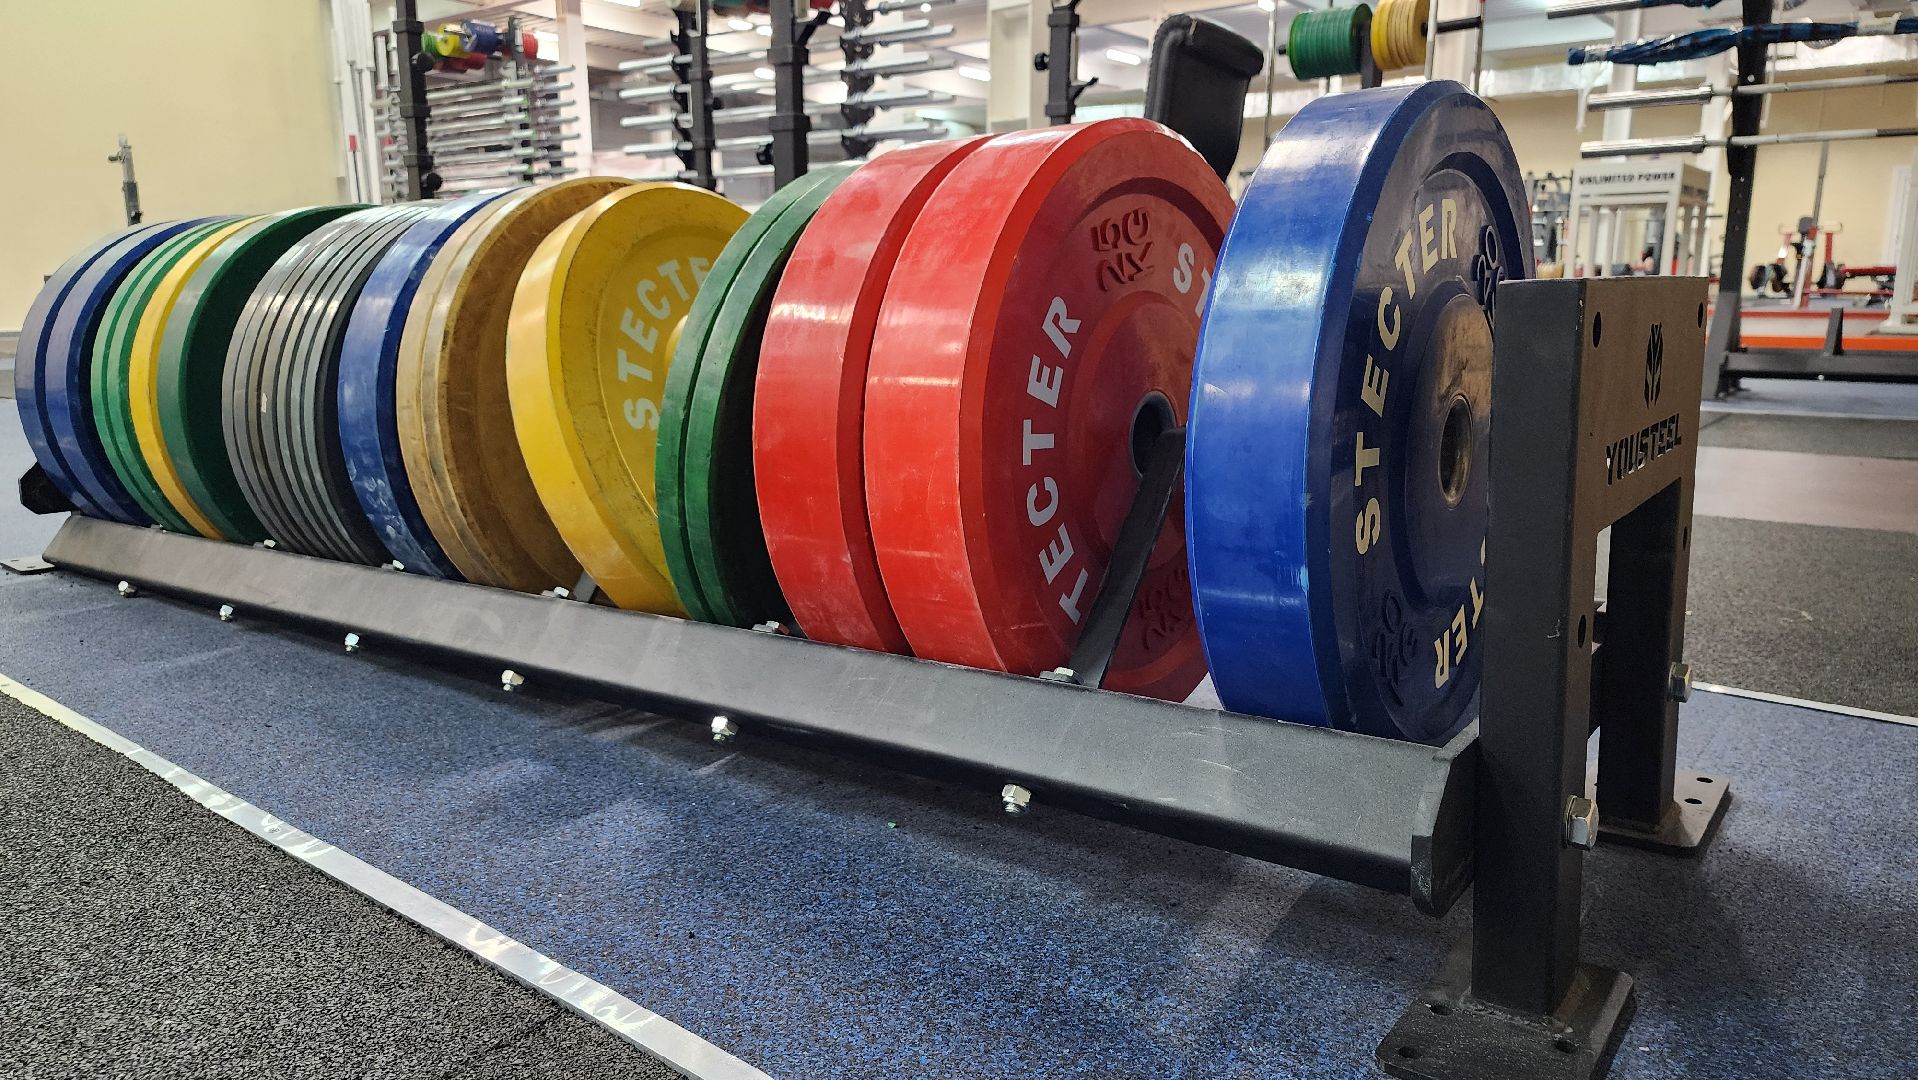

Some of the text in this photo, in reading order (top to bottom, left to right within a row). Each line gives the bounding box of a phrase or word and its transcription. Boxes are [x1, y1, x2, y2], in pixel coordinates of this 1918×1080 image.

[1579, 171, 1675, 186] UNLIMITED POWER
[1355, 197, 1457, 557] STECTER
[1606, 412, 1682, 486] YOUSTEEL
